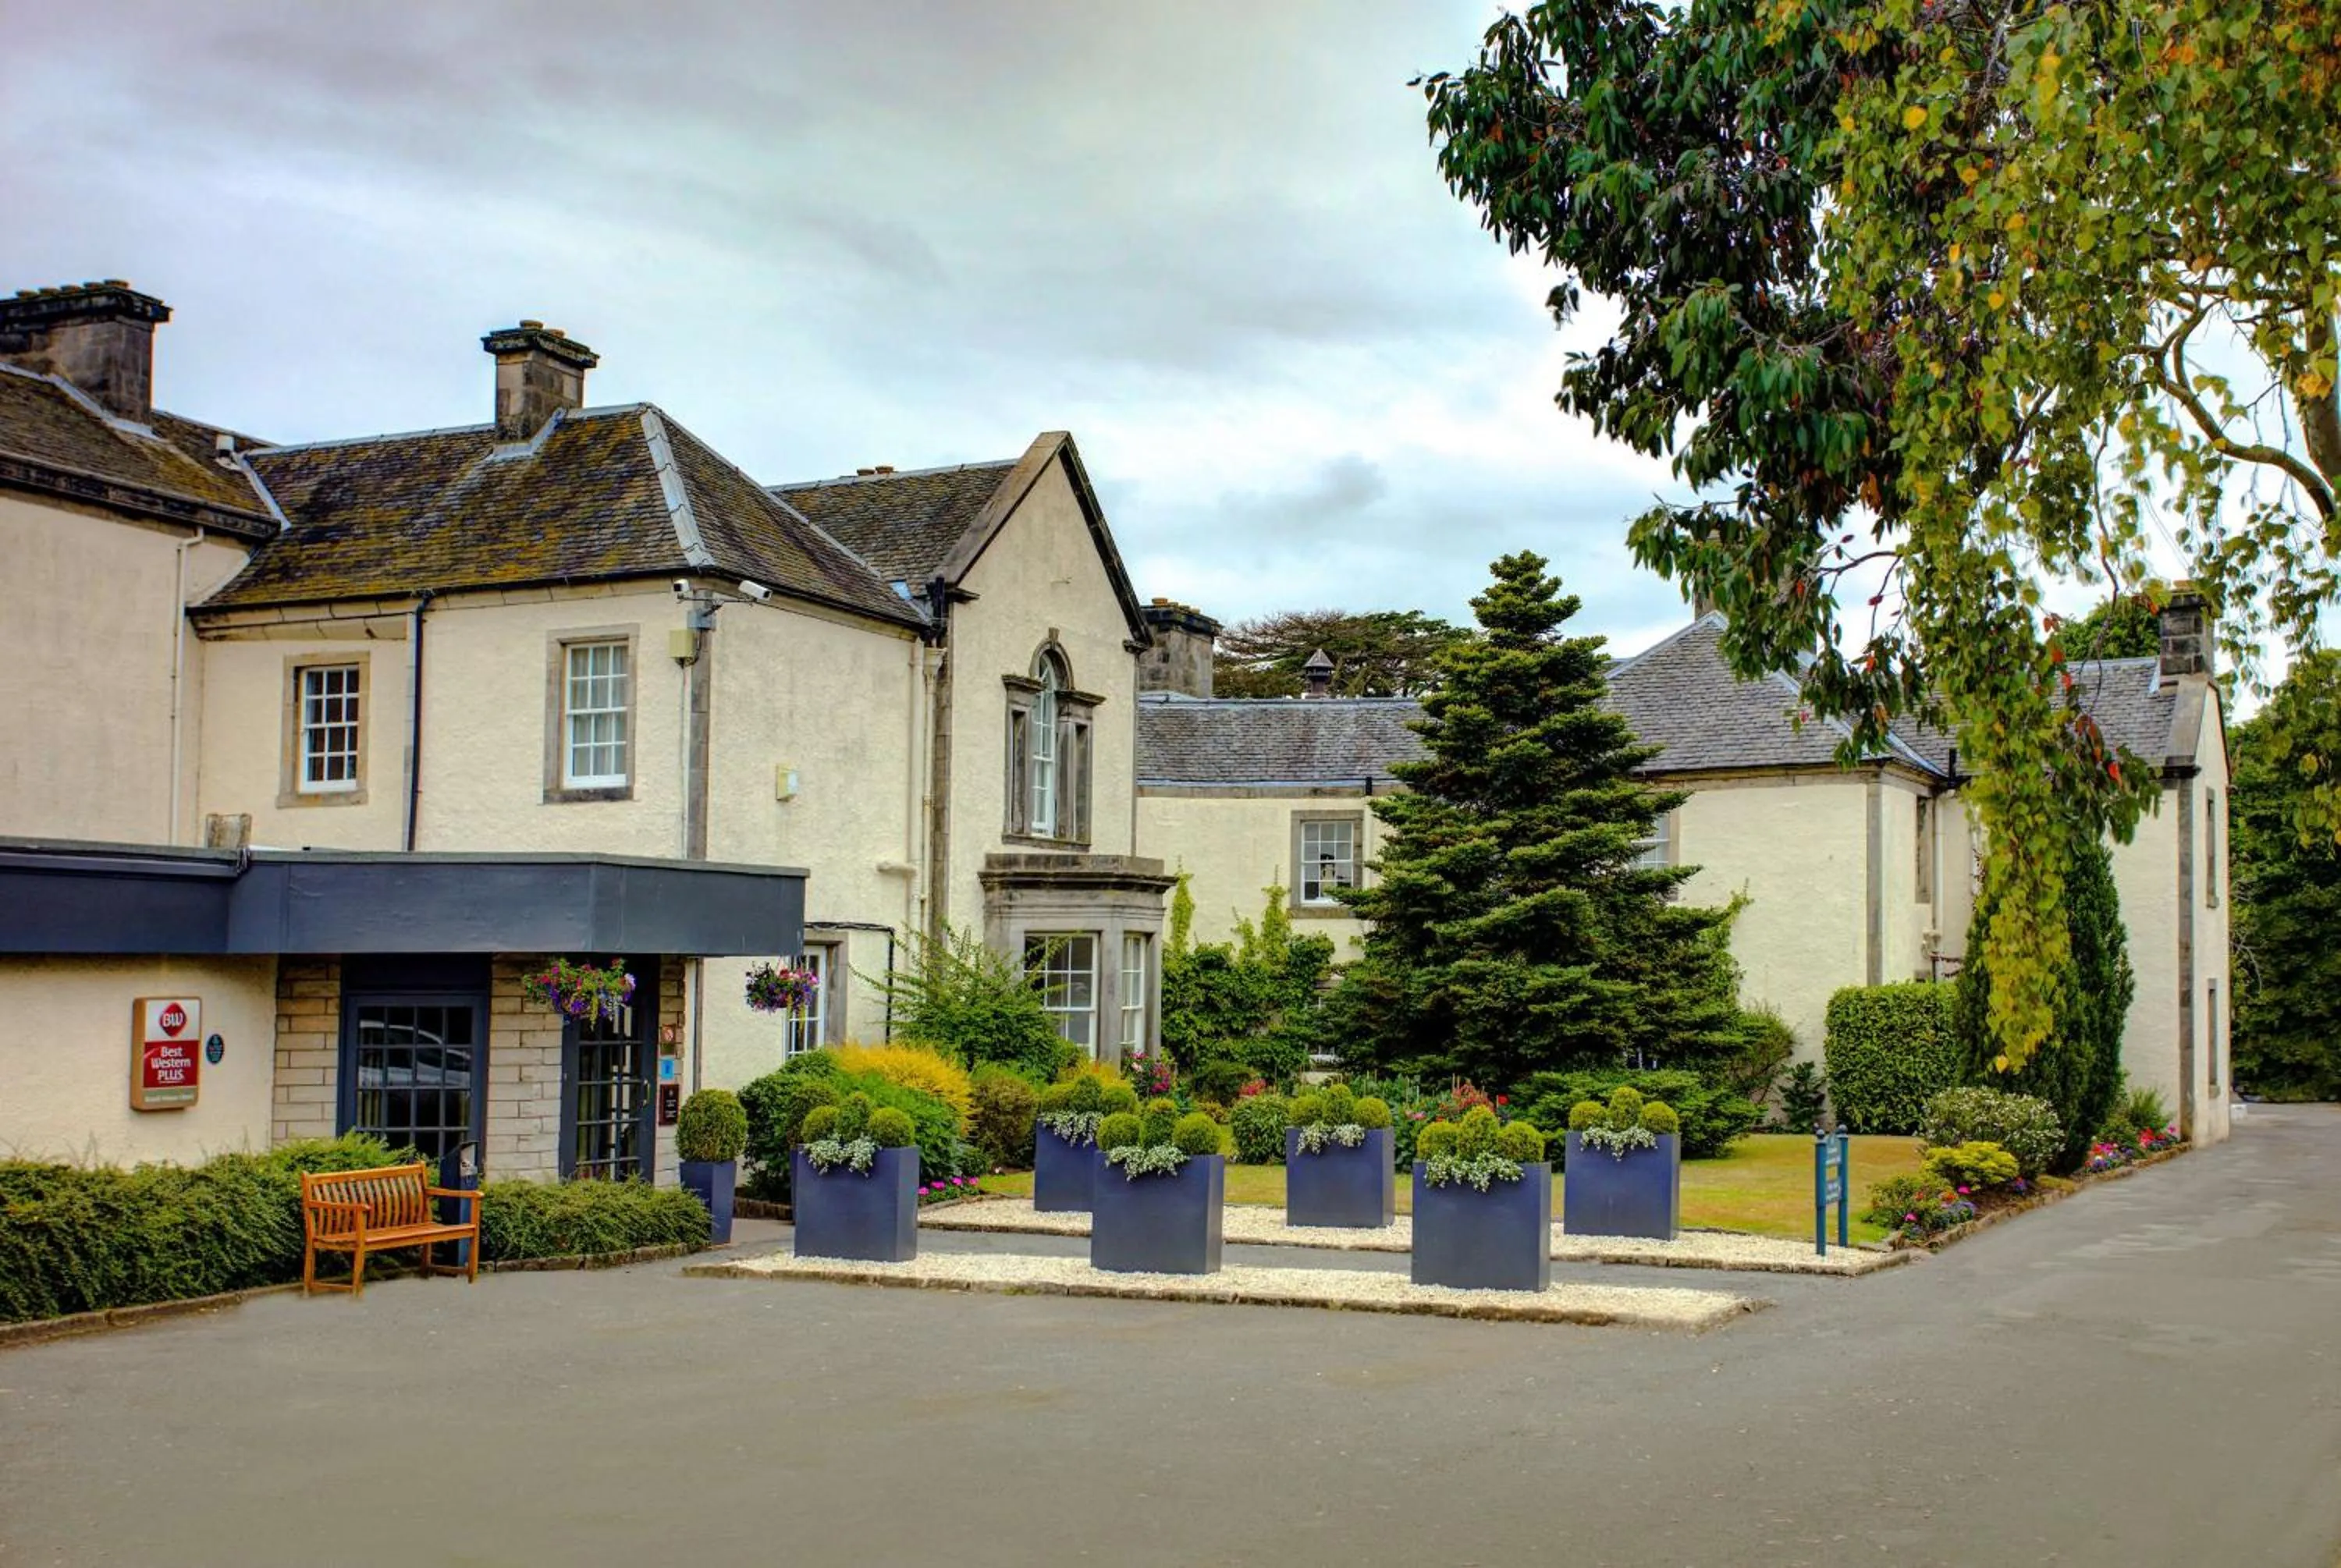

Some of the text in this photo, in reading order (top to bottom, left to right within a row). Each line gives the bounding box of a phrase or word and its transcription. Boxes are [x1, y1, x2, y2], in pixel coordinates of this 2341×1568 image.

[162, 1013, 183, 1027] BW
[161, 1046, 183, 1057] Best
[151, 1057, 190, 1069] Western
[158, 1069, 184, 1080] PLUS
